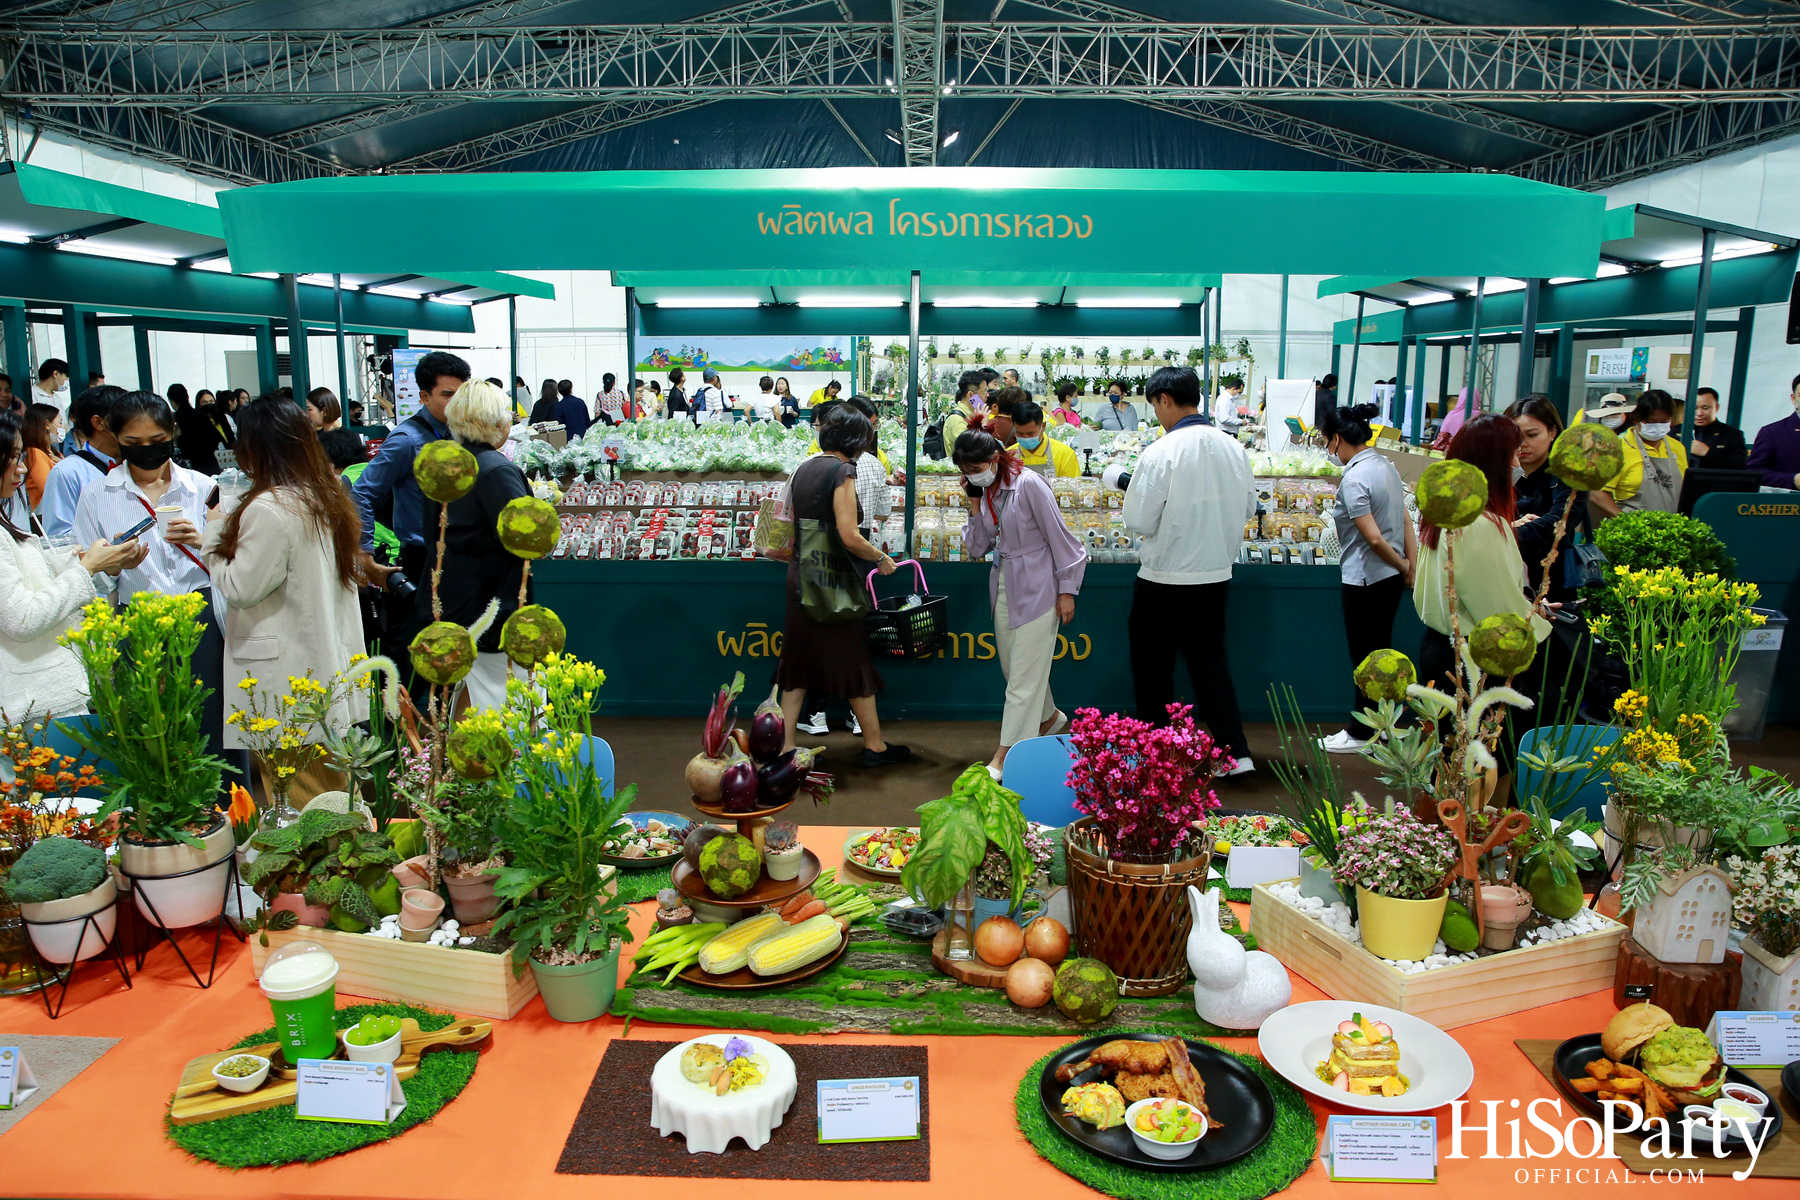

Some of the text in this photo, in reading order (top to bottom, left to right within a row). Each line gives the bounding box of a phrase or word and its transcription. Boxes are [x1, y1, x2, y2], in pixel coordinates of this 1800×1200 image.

[757, 198, 1093, 239] ผลิตผล โครงการหลวง
[1602, 361, 1627, 375] FRESH
[1737, 503, 1800, 516] CASHIER
[286, 1013, 301, 1046] BRIX
